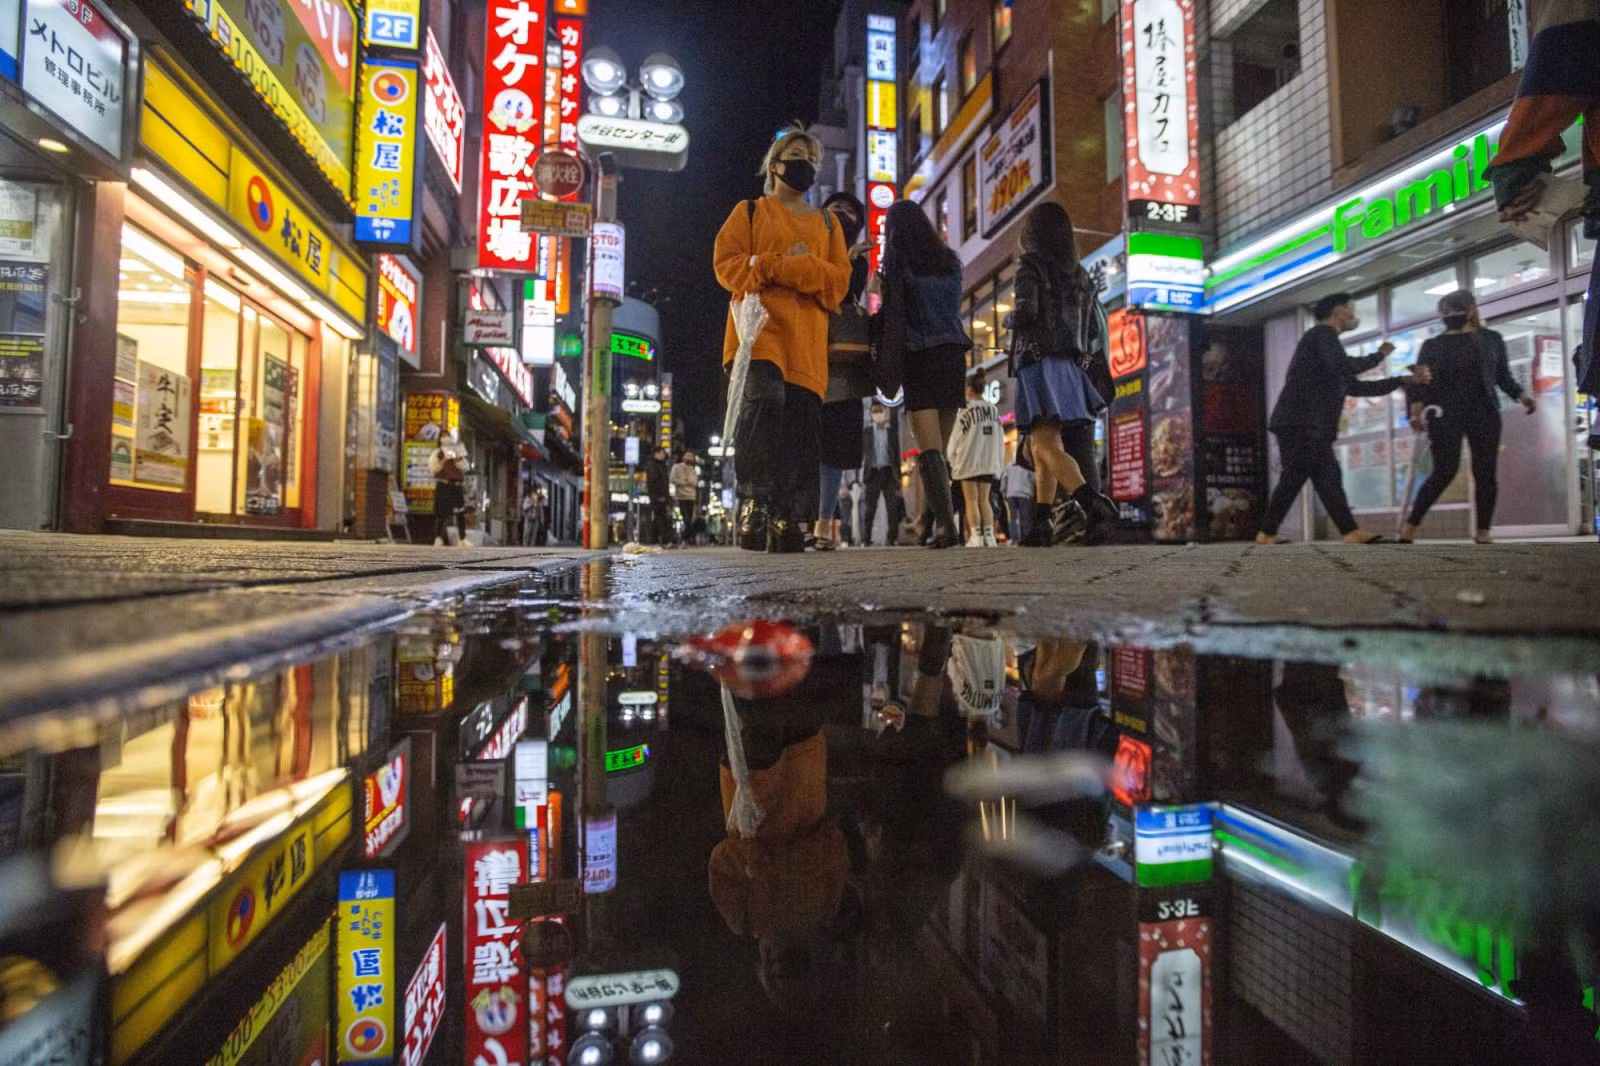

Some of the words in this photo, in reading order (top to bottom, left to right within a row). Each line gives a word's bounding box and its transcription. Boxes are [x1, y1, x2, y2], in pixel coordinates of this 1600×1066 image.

[376, 16, 409, 39] 2F
[29, 18, 121, 104] メトロビル
[372, 109, 403, 170] 松屋
[1332, 133, 1498, 253] Famil
[281, 208, 321, 276] 松屋
[593, 234, 620, 248] STOP
